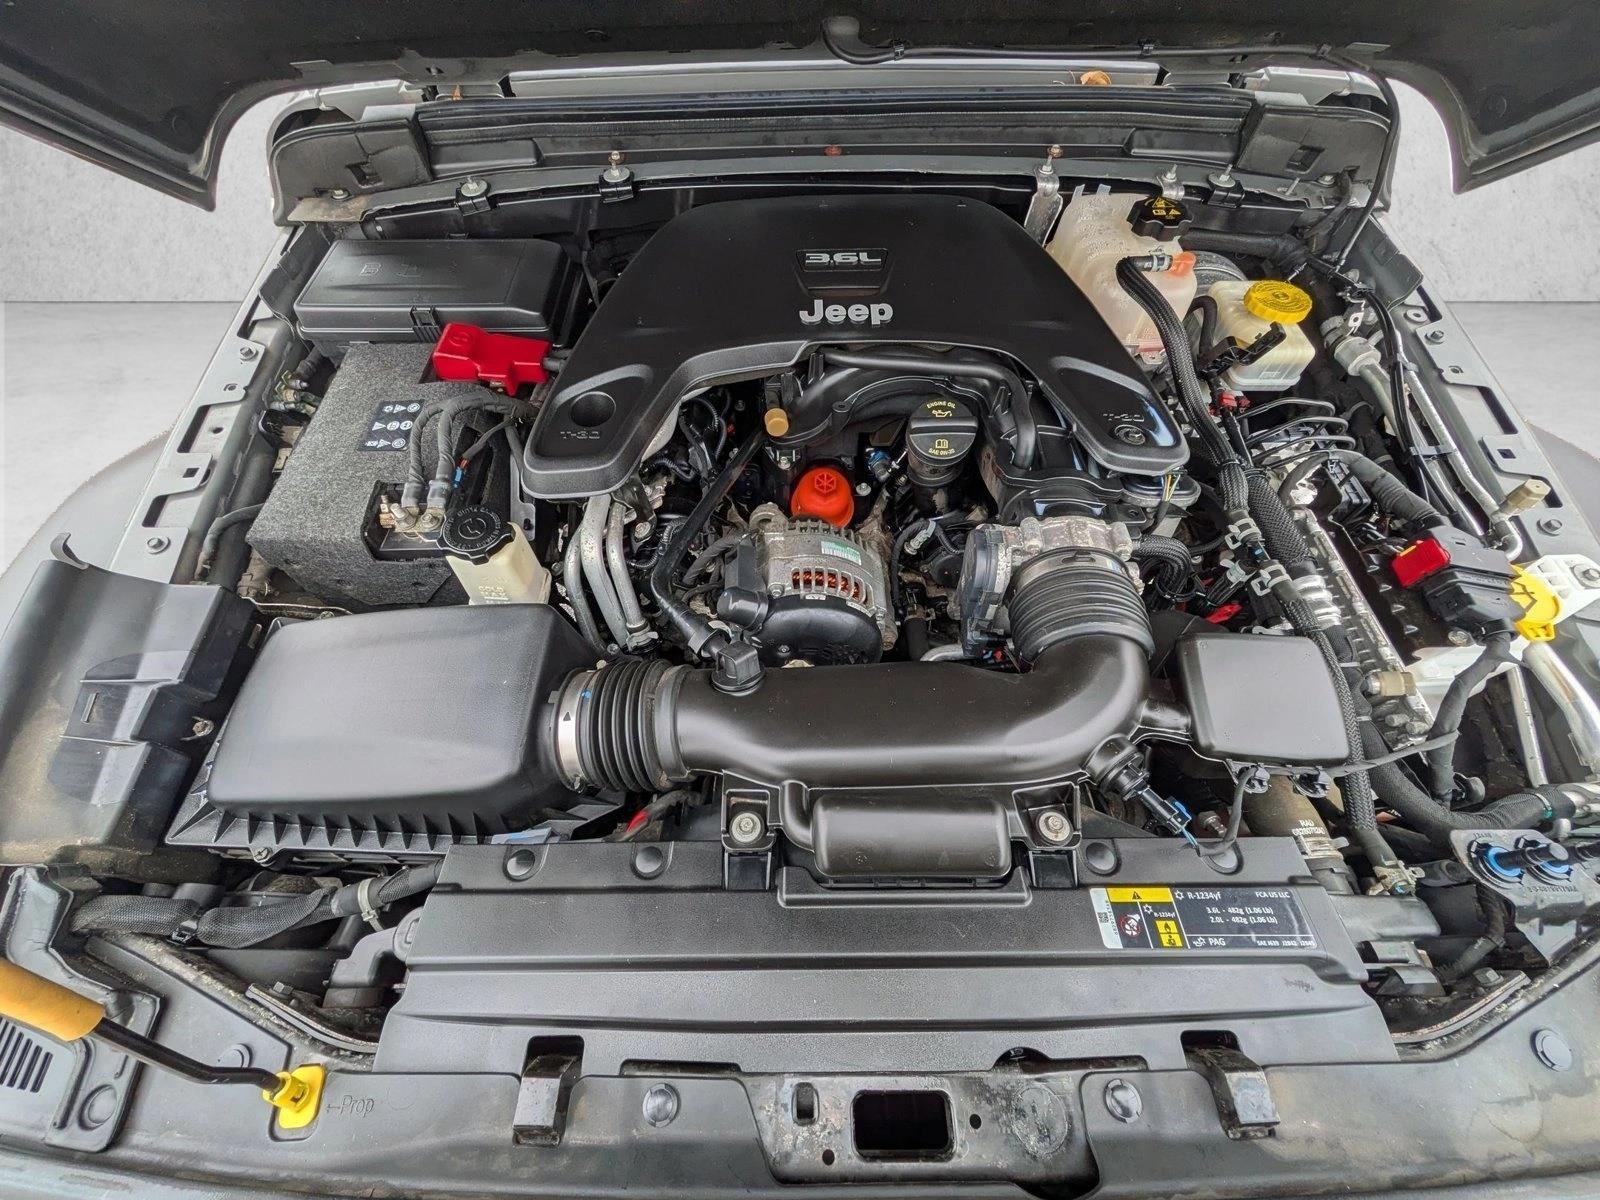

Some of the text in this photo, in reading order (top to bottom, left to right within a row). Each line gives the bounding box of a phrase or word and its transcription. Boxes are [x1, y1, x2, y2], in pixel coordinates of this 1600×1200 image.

[805, 251, 882, 264] 3.6L
[798, 299, 894, 326] Jeep
[926, 400, 957, 409] ENGINE OIL
[928, 447, 939, 456] SAE
[1187, 891, 1222, 900] R-1234yf
[1255, 891, 1291, 899] FCA US LLC
[1206, 906, 1221, 914] 3.6L
[1227, 907, 1245, 915] 482g
[1245, 906, 1262, 915] (1.06
[1262, 906, 1274, 915] Lb)
[1231, 916, 1249, 924] 482g
[1249, 916, 1266, 924] (1.06
[1266, 916, 1278, 925] Lb)
[1208, 937, 1226, 946] PAG
[339, 1094, 375, 1119] Prop
